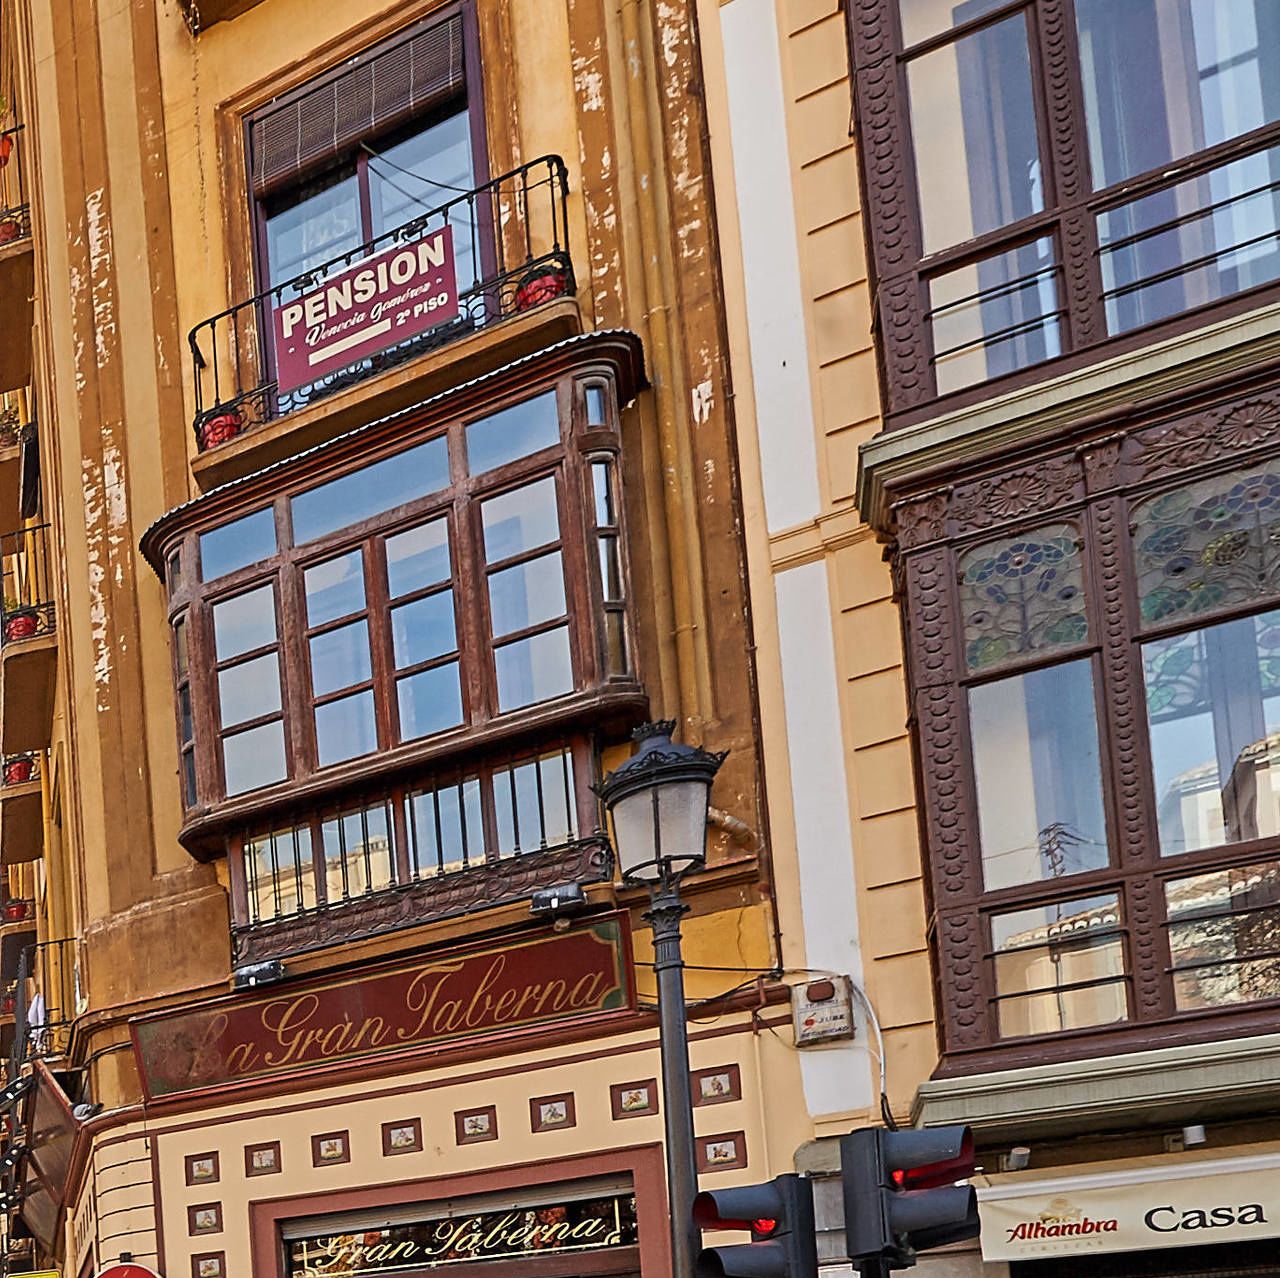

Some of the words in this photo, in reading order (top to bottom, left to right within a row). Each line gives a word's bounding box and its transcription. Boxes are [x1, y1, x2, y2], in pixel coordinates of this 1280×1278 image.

[281, 234, 445, 339] PENSION
[413, 292, 449, 318] PISO
[305, 311, 366, 347] Venecia
[261, 992, 394, 1067] Gran
[396, 954, 614, 1041] Taberna
[314, 1235, 422, 1269] Gran
[424, 1210, 607, 1255] Taberna
[1006, 1216, 1119, 1244] Alhambra
[1144, 1201, 1268, 1234] Casa
